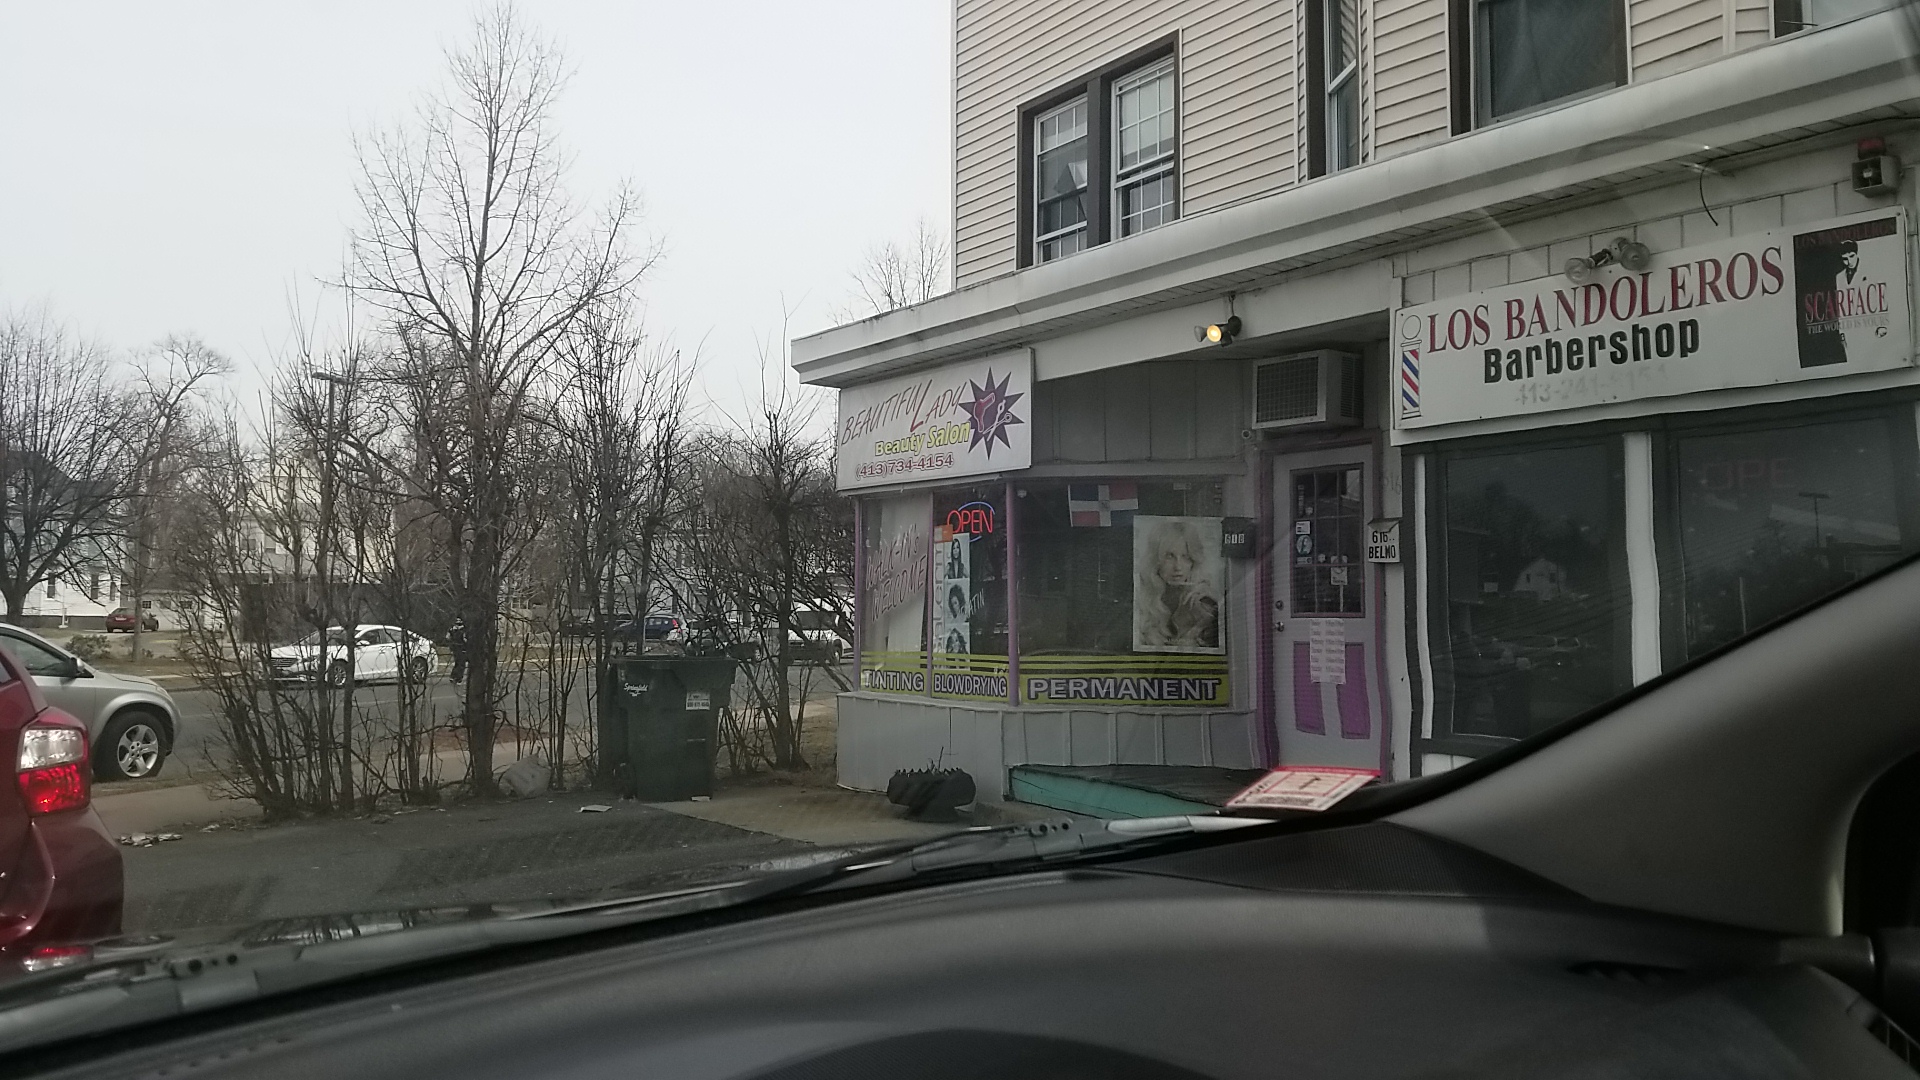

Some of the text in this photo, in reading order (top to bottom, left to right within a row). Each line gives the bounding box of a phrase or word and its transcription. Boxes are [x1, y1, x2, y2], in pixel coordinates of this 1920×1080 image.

[1427, 246, 1785, 354] LOS BANDOLEROS
[1804, 282, 1889, 323] SCARFACE
[1807, 323, 1823, 335] THE
[1824, 320, 1853, 331] WORLD
[1484, 318, 1699, 384] Barbershop
[875, 421, 971, 456] Beauty Salon
[855, 452, 954, 480] (413)734-4154
[947, 509, 993, 534] OPEN
[1368, 545, 1396, 559] BELMO
[871, 554, 926, 623] WELCOME
[864, 669, 925, 693] TINTING
[933, 673, 1008, 698] BLOWDRYING
[1028, 677, 1222, 701] PERMANENT
